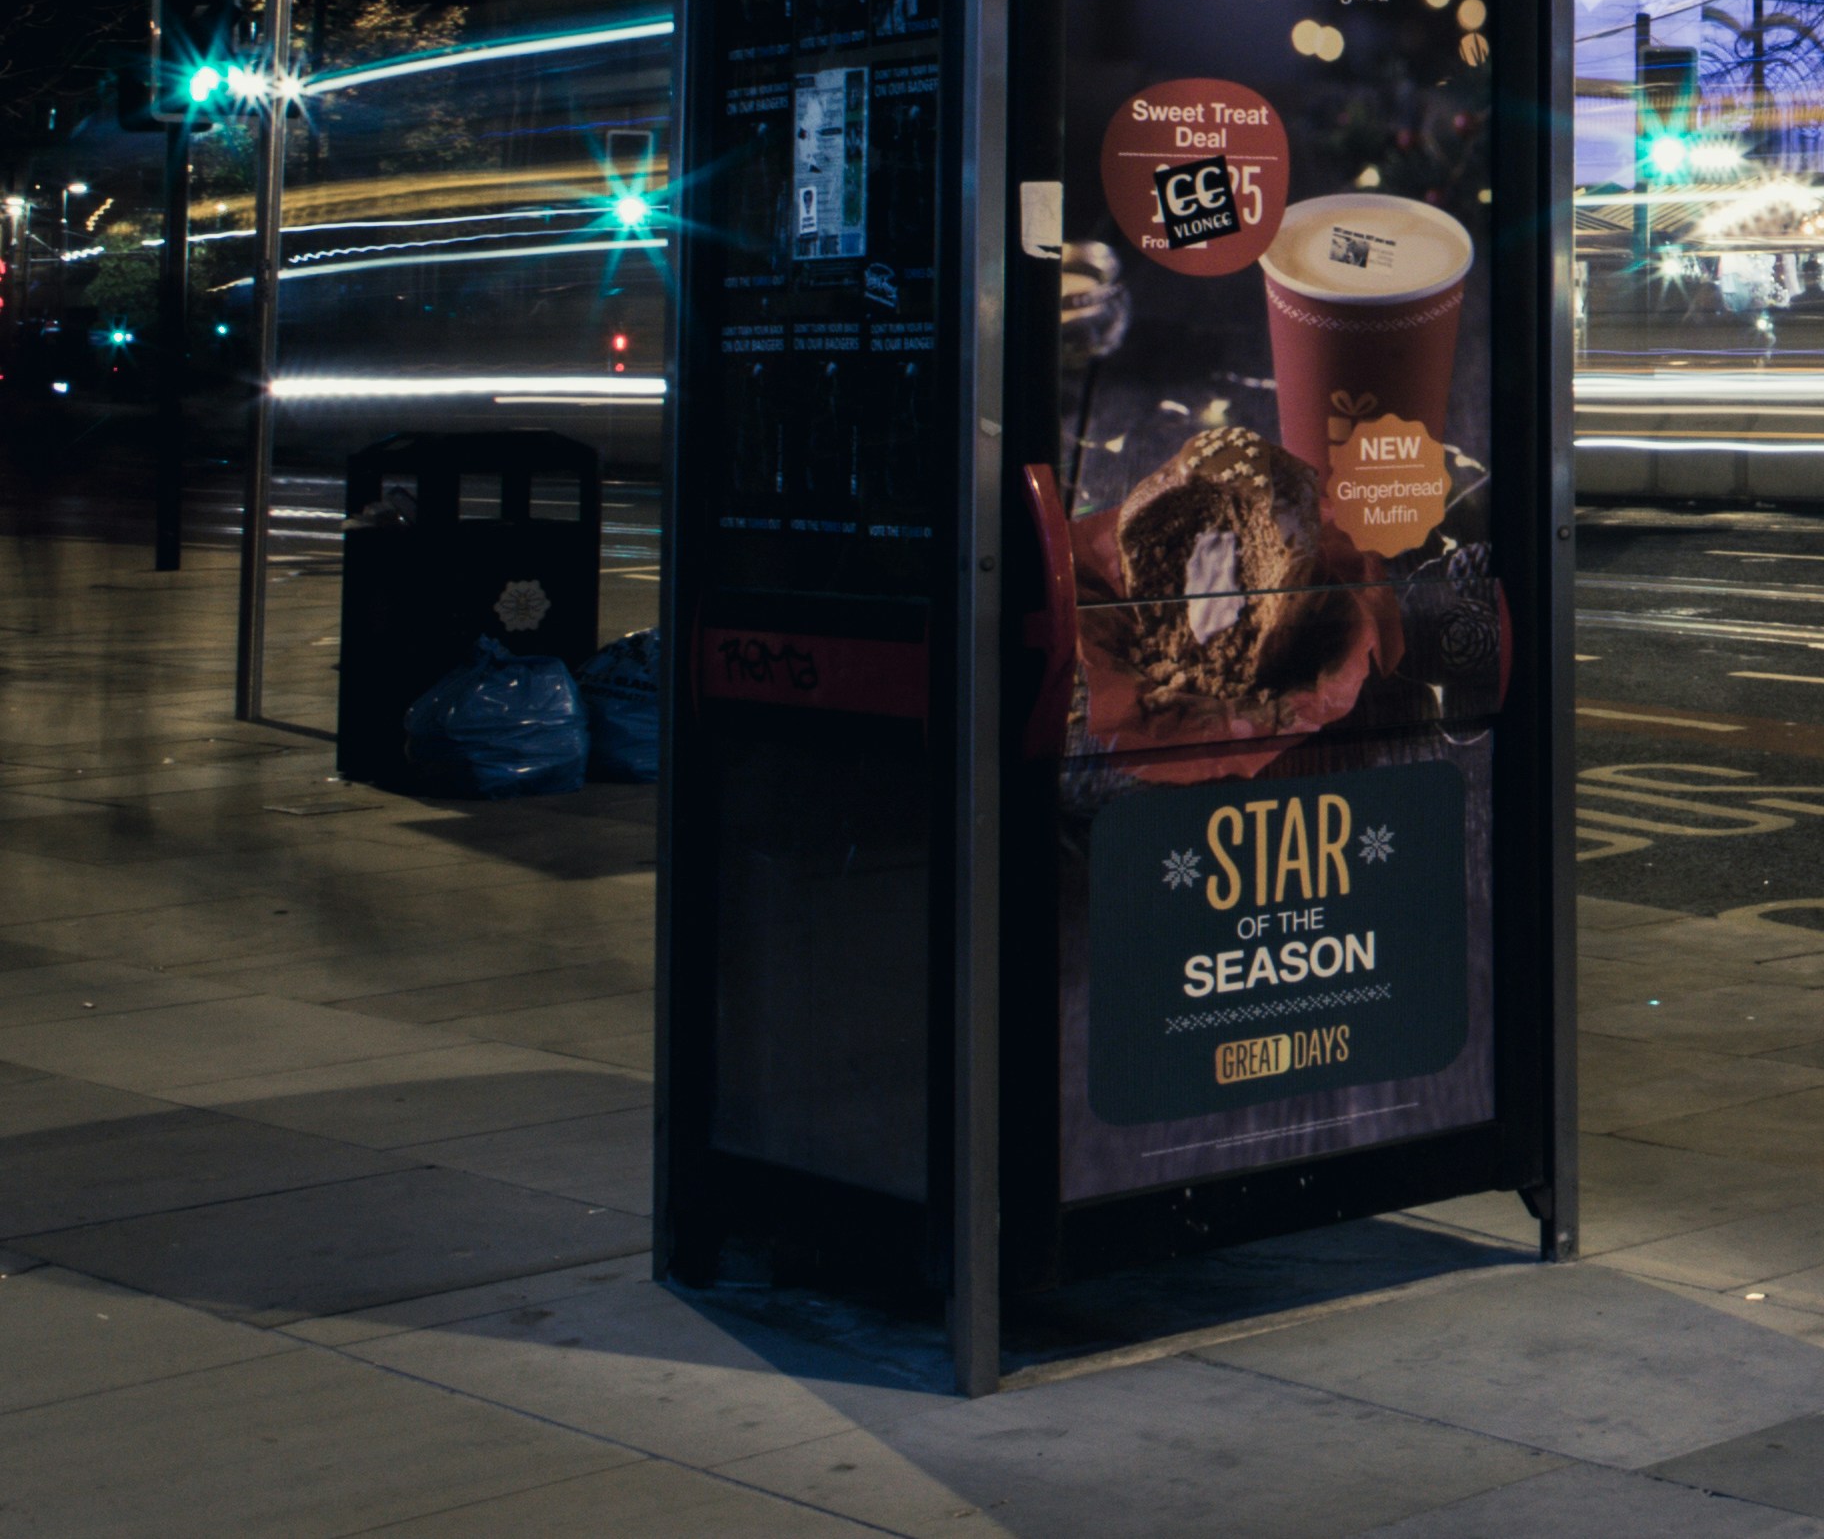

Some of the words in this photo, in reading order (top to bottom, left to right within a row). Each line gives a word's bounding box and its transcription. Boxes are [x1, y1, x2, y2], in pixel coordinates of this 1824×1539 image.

[1132, 99, 1205, 123] Sweet
[1210, 102, 1269, 125] Treat
[1175, 126, 1227, 148] Deal
[1141, 235, 1170, 249] Fro
[1361, 436, 1421, 461] NEW
[1337, 478, 1443, 503] Gingerbread
[1363, 504, 1418, 525] Muffin
[1206, 793, 1352, 910] STAR
[1237, 914, 1270, 940] OF
[1277, 907, 1325, 934] THE
[1183, 930, 1376, 997] SEASON
[1222, 1036, 1284, 1079] GREAT
[1293, 1024, 1350, 1070] DAYS
